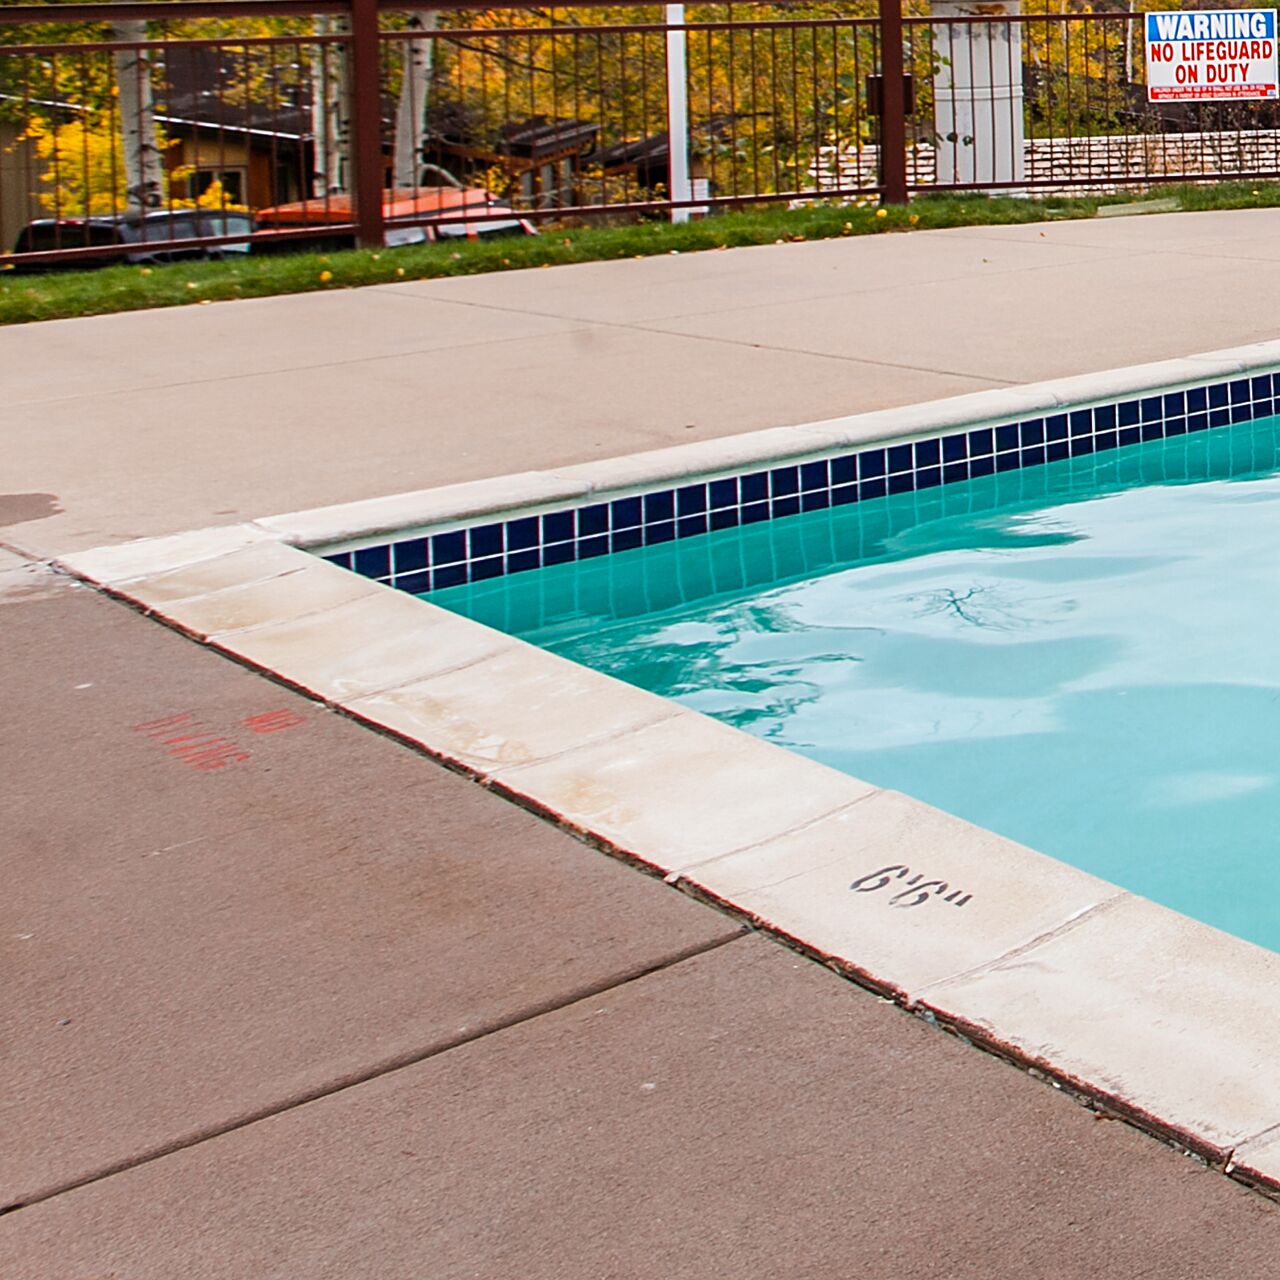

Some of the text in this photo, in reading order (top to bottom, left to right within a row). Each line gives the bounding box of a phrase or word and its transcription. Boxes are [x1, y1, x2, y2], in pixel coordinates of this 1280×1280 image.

[1156, 13, 1266, 40] WARNING
[1151, 41, 1273, 62] NO LIFEGUARD
[1175, 63, 1249, 84] ON DUTY
